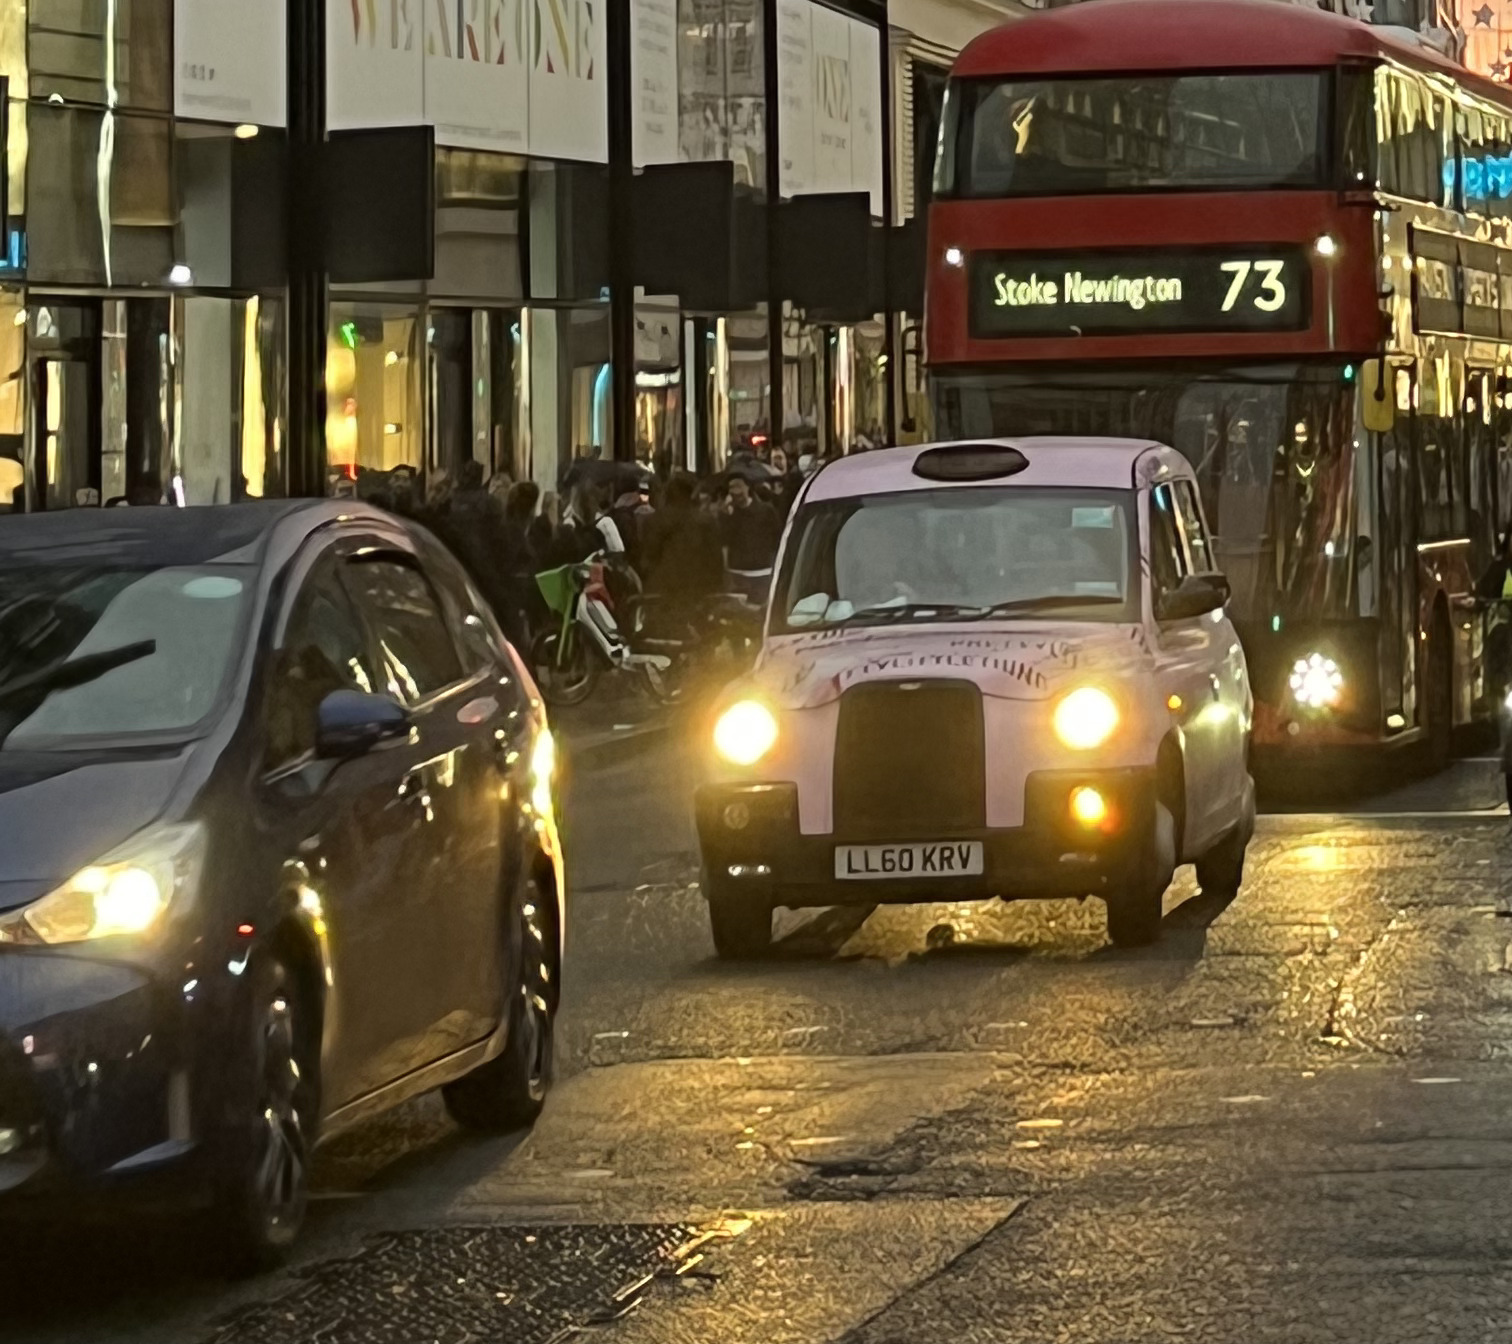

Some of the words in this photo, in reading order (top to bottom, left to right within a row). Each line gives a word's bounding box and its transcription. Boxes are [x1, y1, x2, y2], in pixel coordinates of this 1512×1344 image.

[994, 272, 1058, 306] Stoke
[1063, 271, 1183, 310] Newington
[1219, 259, 1287, 312] 73
[846, 848, 915, 874] LL60
[921, 843, 972, 873] KRV
